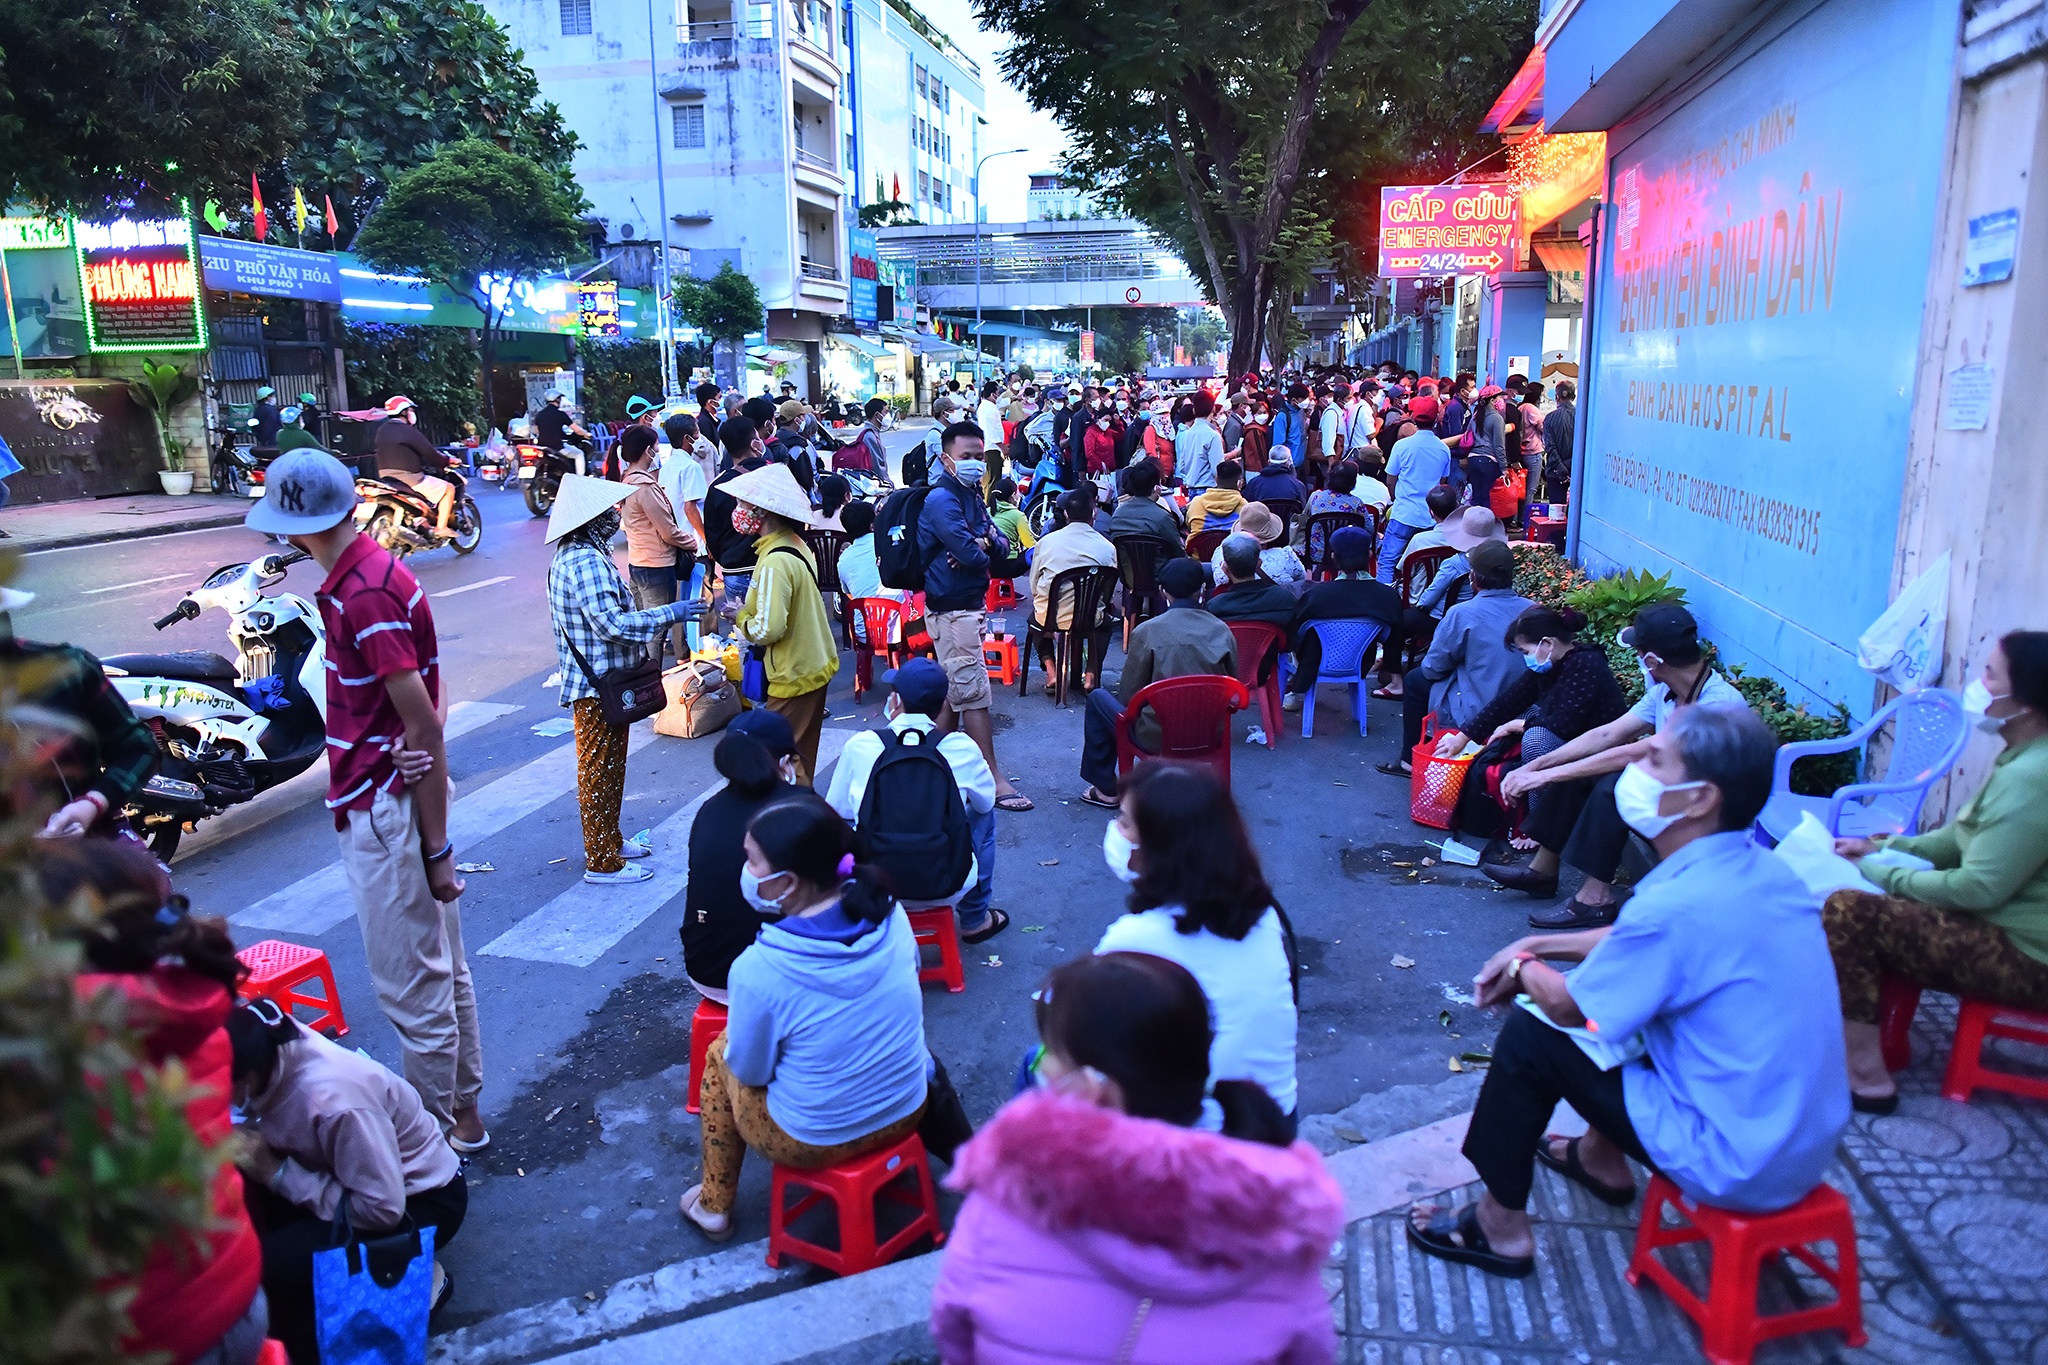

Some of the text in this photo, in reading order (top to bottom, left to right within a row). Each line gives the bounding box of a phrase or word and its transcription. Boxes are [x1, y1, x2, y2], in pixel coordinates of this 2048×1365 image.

[1387, 190, 1446, 222] CẤP
[1383, 224, 1513, 249] EMERGENCY
[1705, 202, 1765, 326] BÌNH
[1765, 171, 1843, 318] DÂN
[234, 259, 266, 276] PHỐ
[267, 263, 298, 280] VĂN
[301, 267, 332, 284] HÓA
[1419, 253, 1466, 271] 24/24
[84, 257, 194, 302] PHƯƠNG NAM
[237, 275, 266, 286] KHU
[268, 277, 295, 289] PHỐ
[297, 282, 304, 290] 1
[1628, 380, 1792, 443] BINH DAN HOSPITAL
[280, 478, 305, 512] NY
